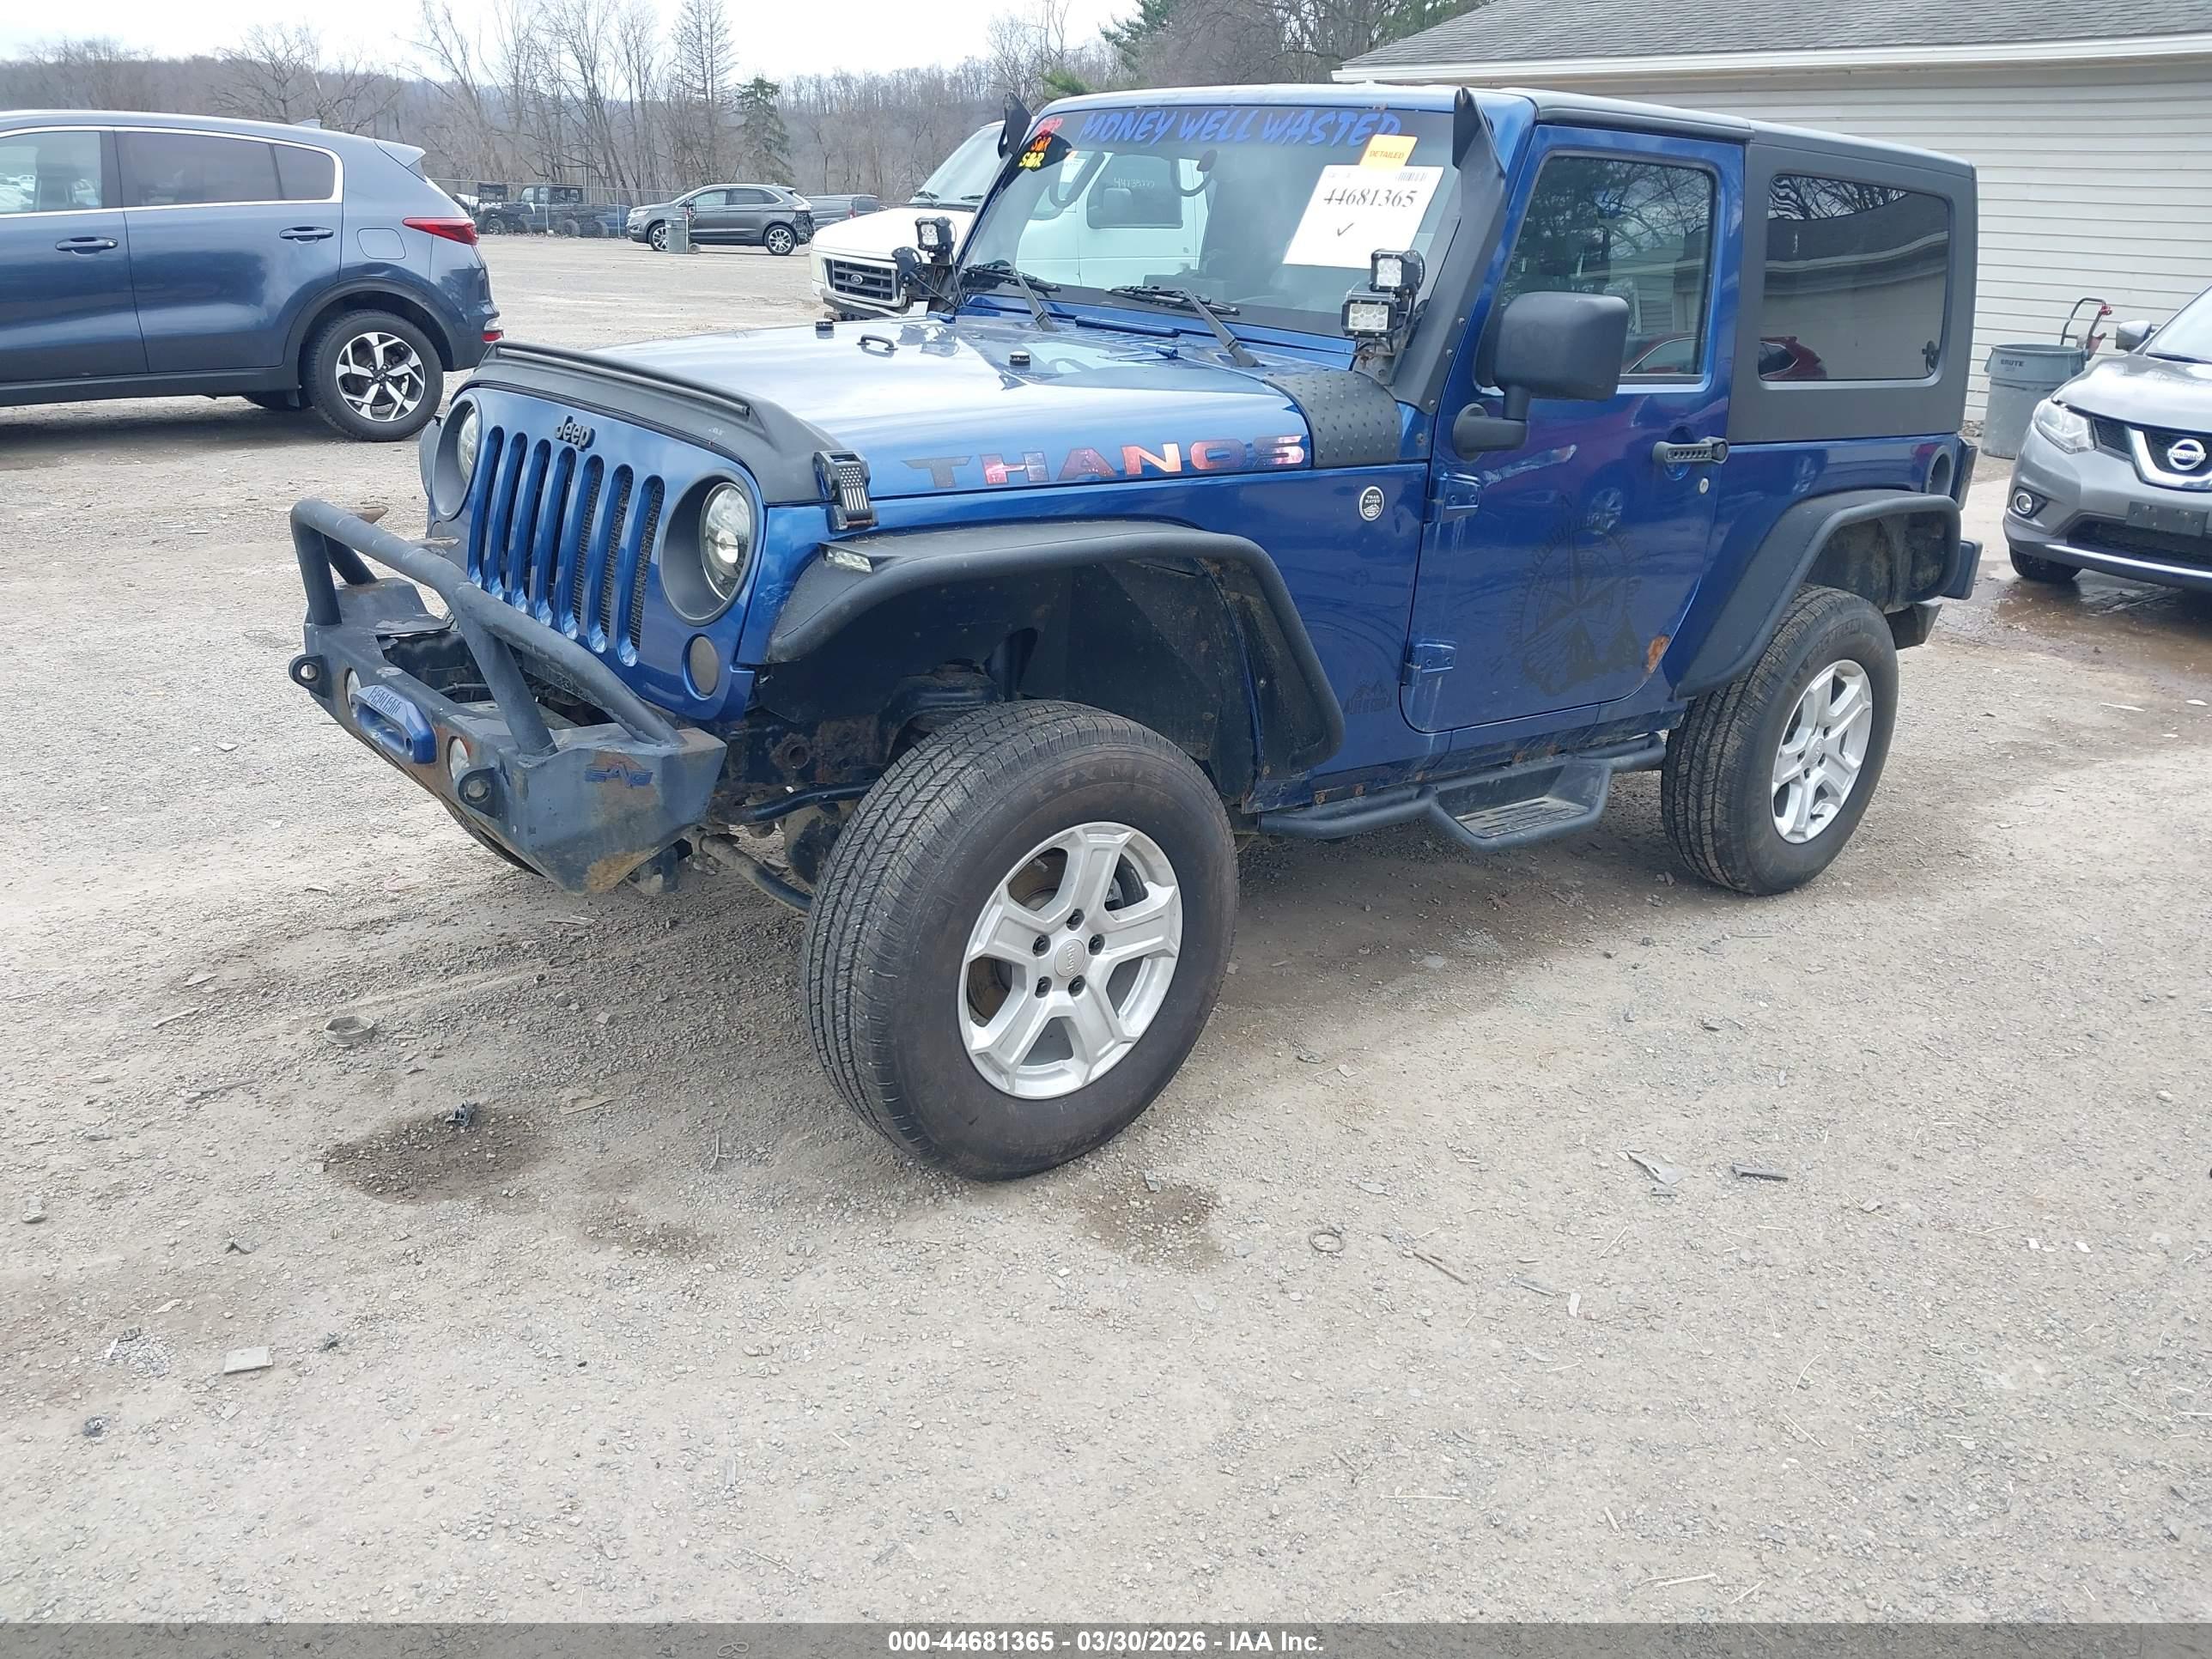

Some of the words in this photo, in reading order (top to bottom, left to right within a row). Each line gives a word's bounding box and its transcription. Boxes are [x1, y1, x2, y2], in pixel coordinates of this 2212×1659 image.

[1078, 110, 1176, 146] MONEY
[1179, 110, 1259, 143] WELL
[1263, 109, 1401, 147] WASTED
[1369, 150, 1404, 159] DETAILED
[1323, 187, 1419, 208] 44681365
[2001, 359, 2024, 368] BRUTE
[555, 416, 596, 453] Jeep
[900, 434, 1304, 489] THANOS
[1032, 766, 1101, 804] LTX
